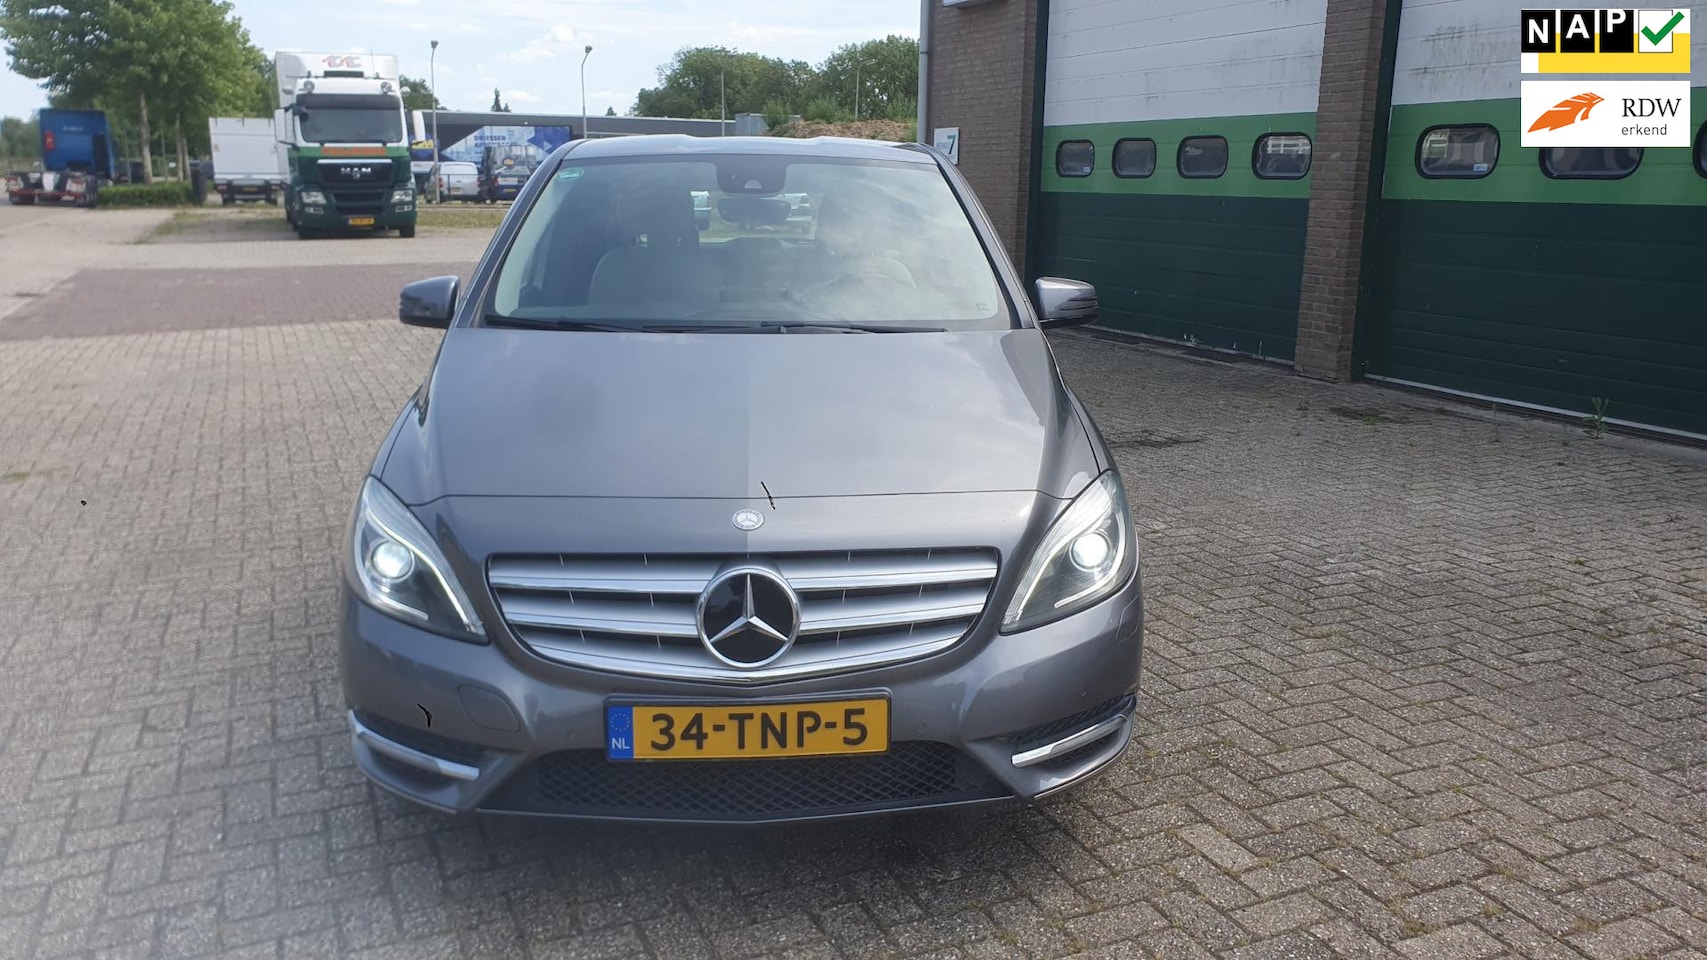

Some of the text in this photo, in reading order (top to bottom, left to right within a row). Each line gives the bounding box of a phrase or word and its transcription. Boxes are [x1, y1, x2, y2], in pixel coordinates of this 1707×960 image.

[946, 134, 957, 155] 7
[651, 707, 868, 751] 34-TNP-5
[611, 737, 630, 750] NL
